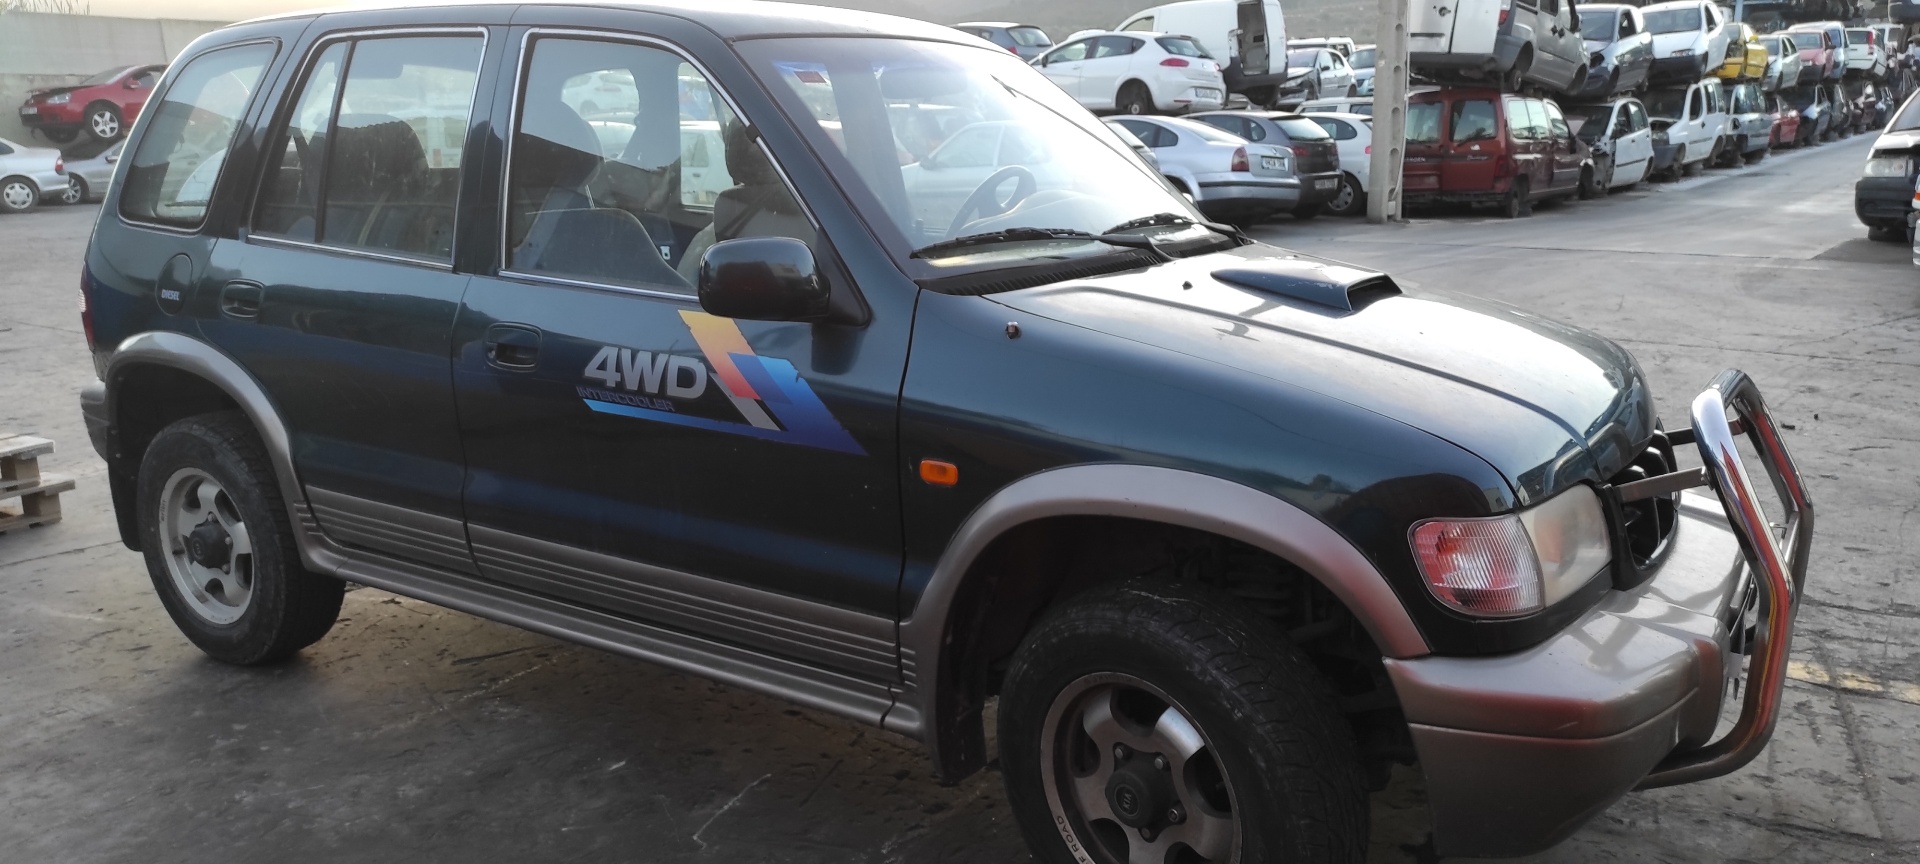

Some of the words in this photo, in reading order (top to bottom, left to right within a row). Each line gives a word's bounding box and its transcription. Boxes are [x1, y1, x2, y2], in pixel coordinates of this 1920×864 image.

[161, 289, 180, 301] DIESEL
[583, 345, 708, 400] 4WD
[575, 385, 676, 413] INTERCOOLER
[1056, 815, 1080, 853] ROAD
